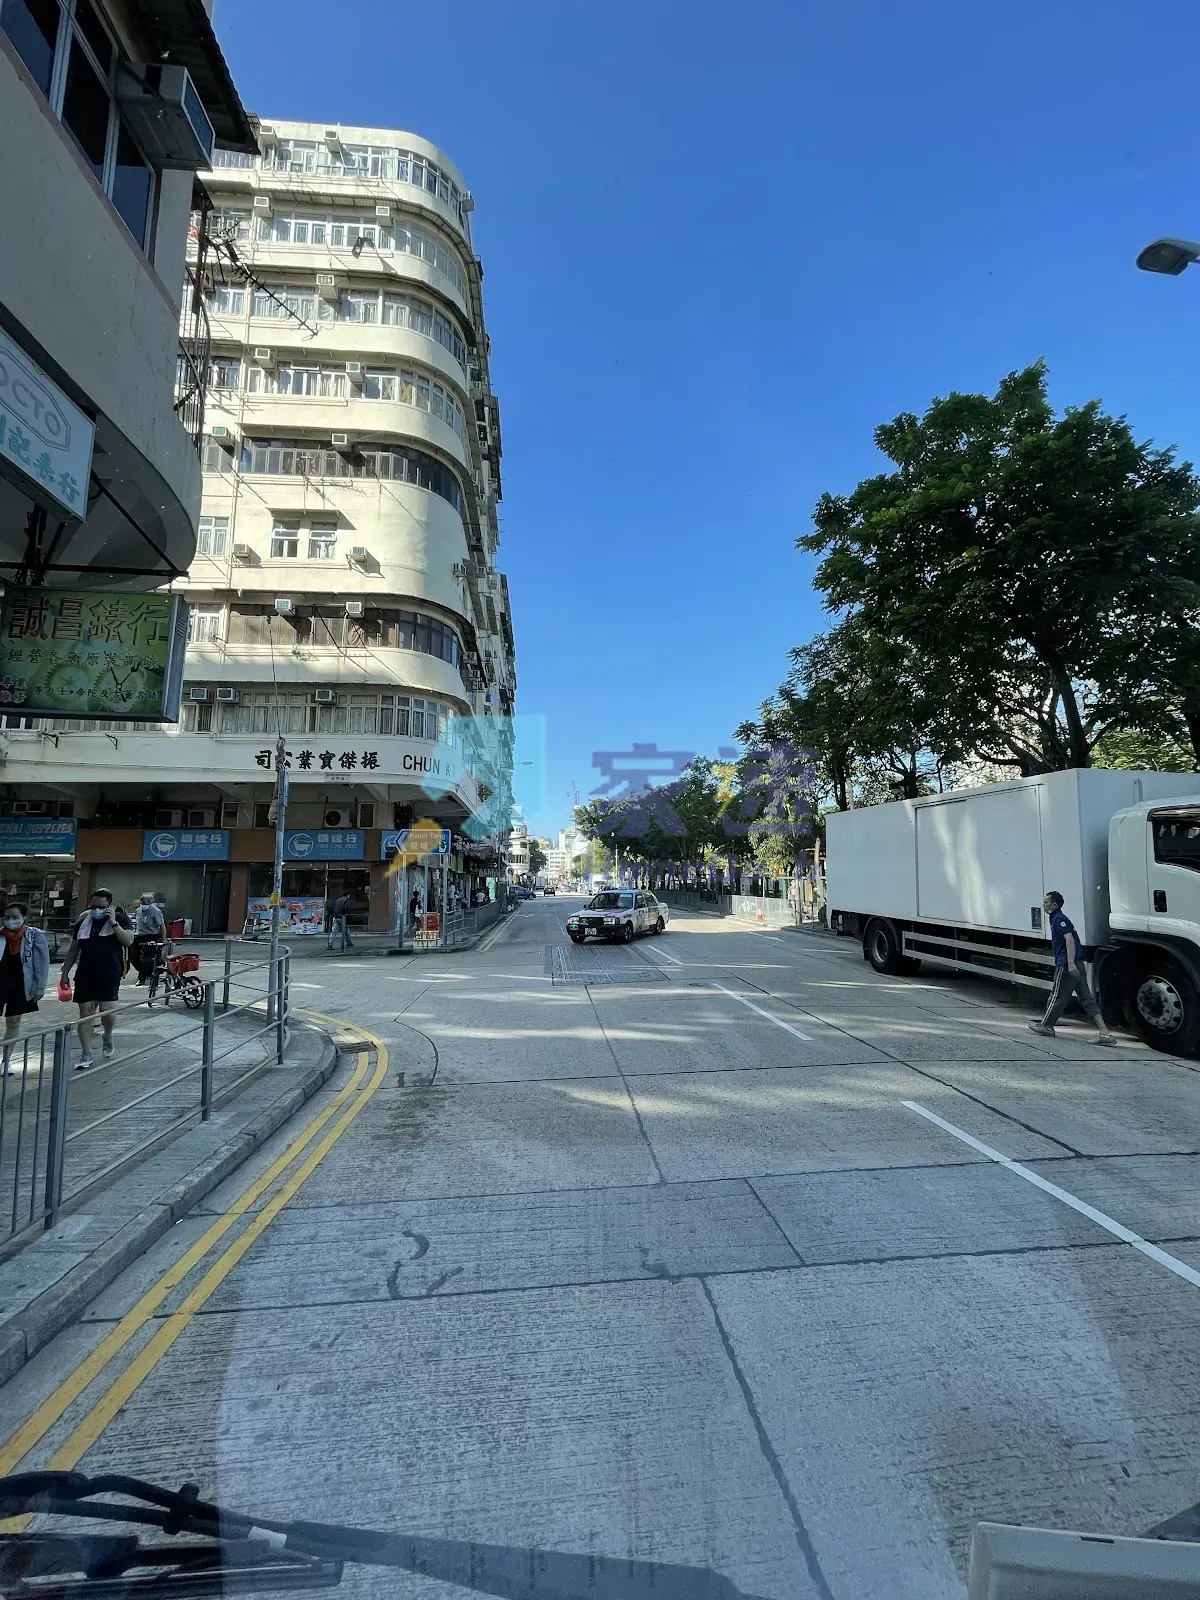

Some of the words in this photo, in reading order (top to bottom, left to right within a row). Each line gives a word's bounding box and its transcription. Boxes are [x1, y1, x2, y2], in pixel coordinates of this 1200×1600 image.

[8, 596, 169, 647] 誠昌錶行
[402, 754, 441, 775] CHUN
[430, 832, 446, 840] Tong
